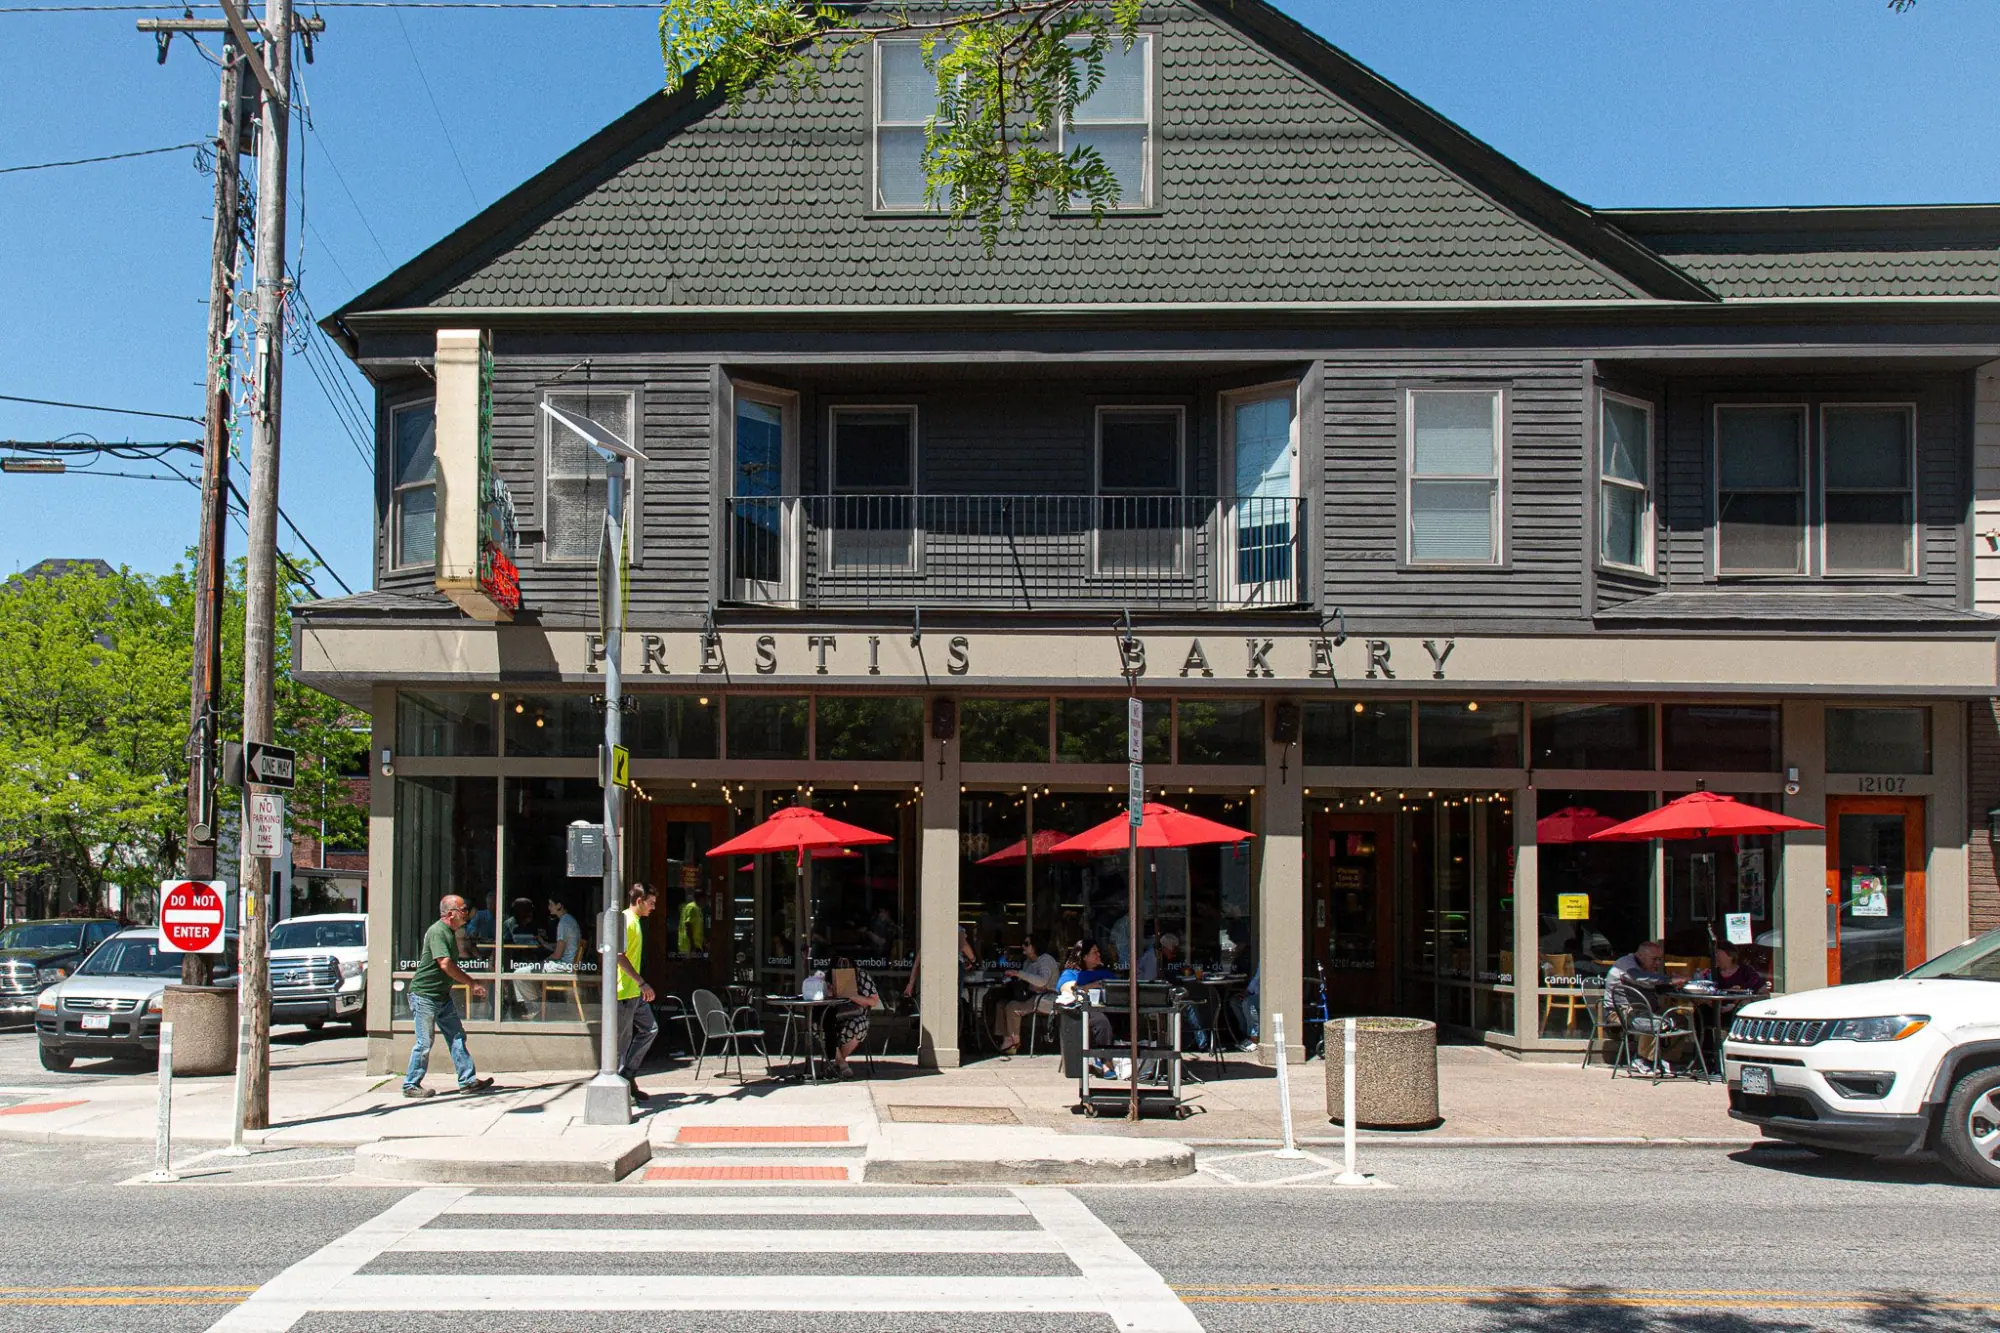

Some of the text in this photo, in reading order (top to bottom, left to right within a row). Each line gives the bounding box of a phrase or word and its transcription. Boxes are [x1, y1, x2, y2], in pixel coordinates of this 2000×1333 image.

[1119, 638, 1455, 678] BAKERY
[261, 757, 291, 777] ONE WAY
[1858, 777, 1906, 793] 12107
[259, 802, 273, 813] NO
[252, 814, 280, 824] PARKING
[258, 825, 272, 833] ANY
[257, 835, 272, 843] TIME
[170, 895, 216, 907] DO NOT
[173, 926, 210, 938] ENTER
[510, 960, 541, 969] lemon
[566, 961, 598, 973] gelato
[767, 956, 792, 965] cannoli
[813, 957, 832, 967] past
[893, 956, 913, 967] subs
[981, 958, 1022, 968] tira misu
[1113, 960, 1131, 970] sub
[1544, 974, 1582, 984] cannoli
